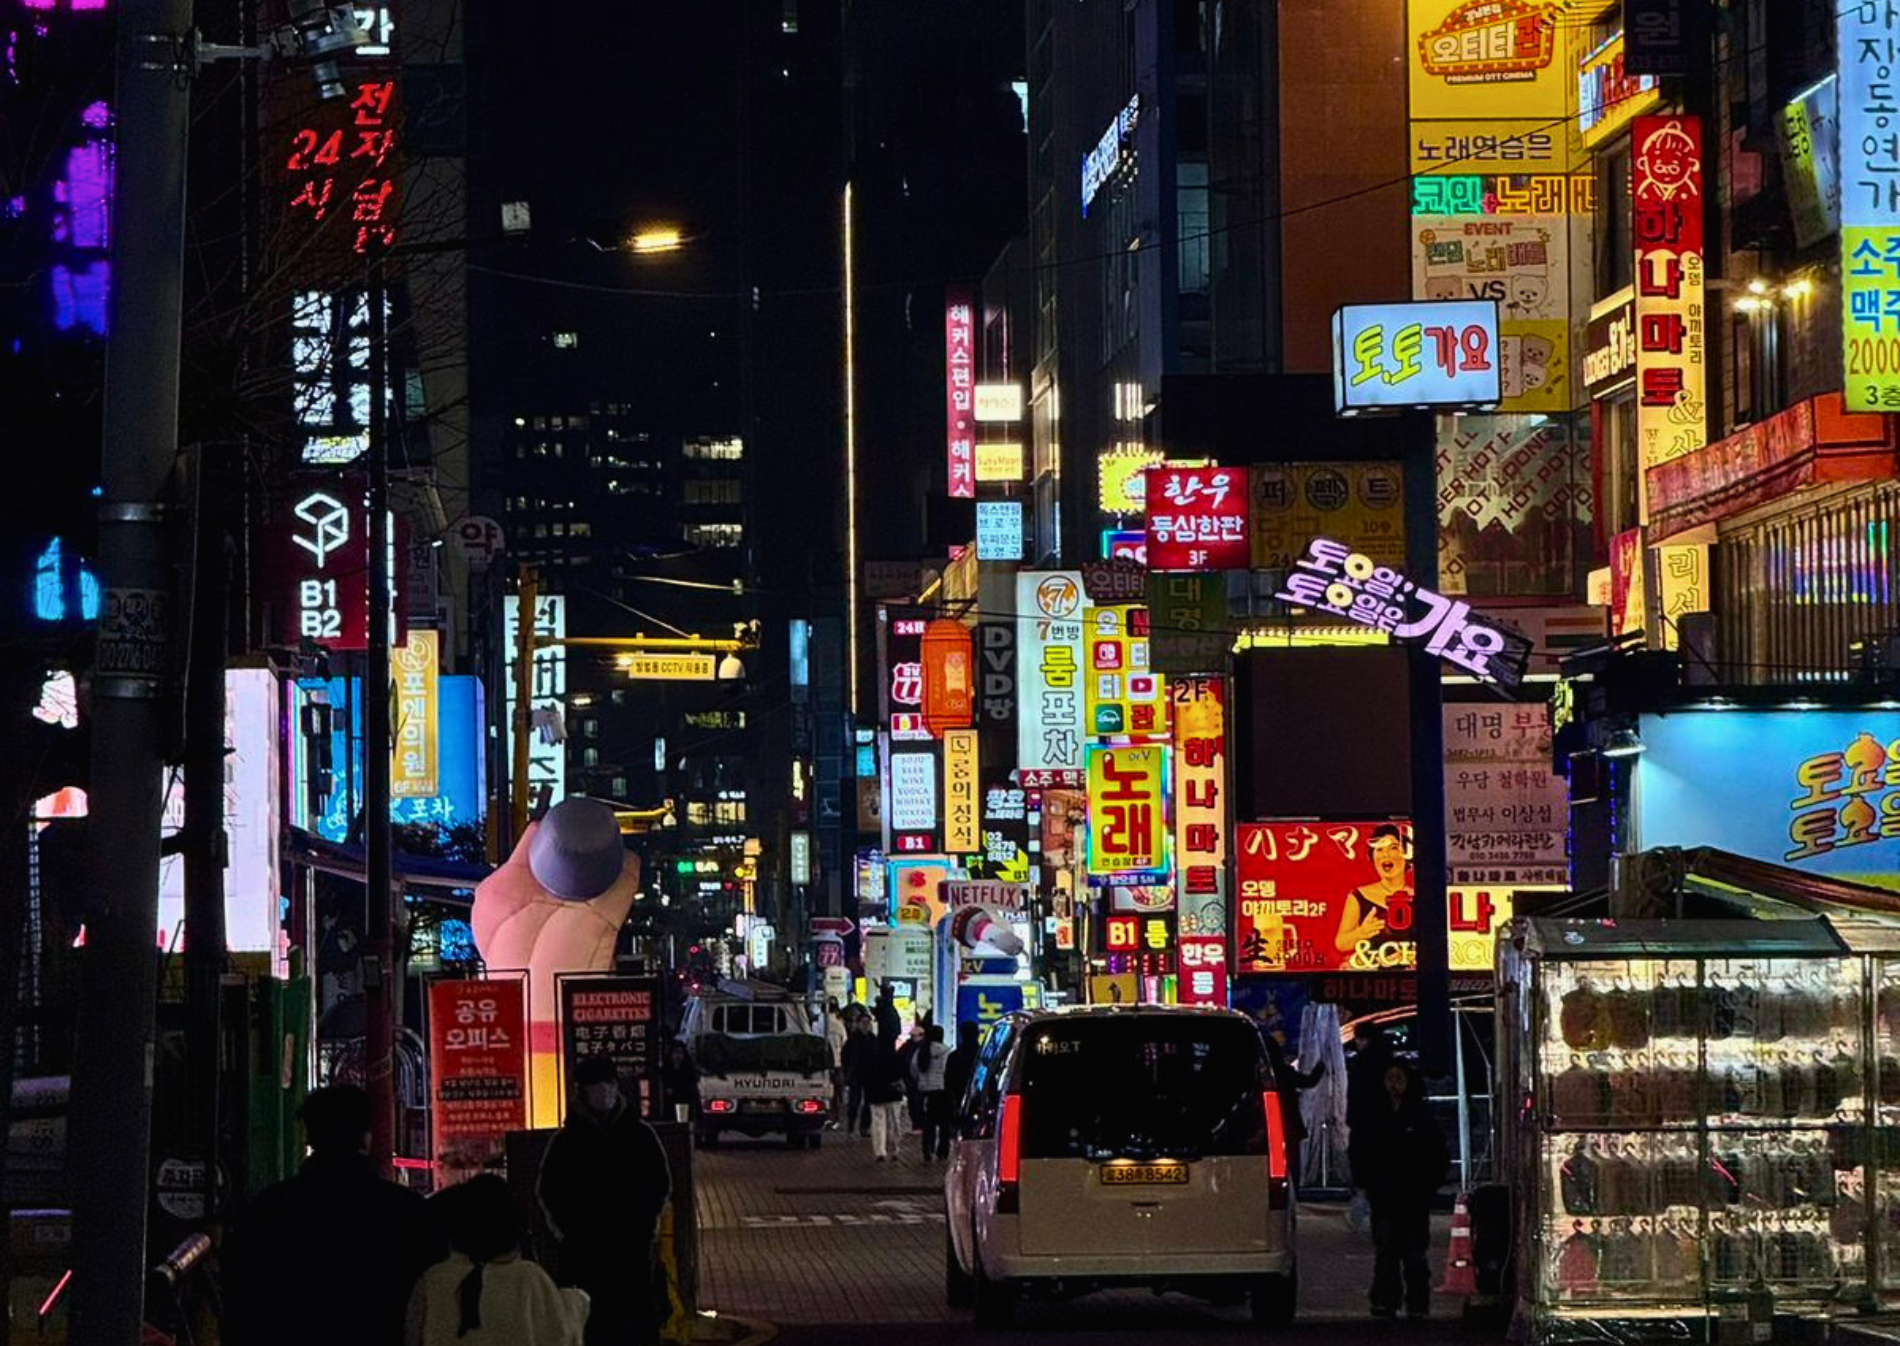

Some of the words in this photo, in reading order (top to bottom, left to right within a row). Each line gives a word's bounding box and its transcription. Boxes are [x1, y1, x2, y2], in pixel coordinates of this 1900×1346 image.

[1485, 72, 1501, 82] OTT
[1417, 134, 1552, 161] 노래연습은
[1464, 223, 1513, 236] EVENT
[1469, 281, 1506, 300] VS
[1163, 474, 1231, 509] 한우
[1151, 514, 1244, 543] 등심한판
[1188, 550, 1208, 566] 3F
[301, 579, 336, 608] B1
[301, 610, 341, 638] B2
[1037, 621, 1080, 640] 7번방
[661, 662, 684, 673] CCTV
[1176, 680, 1208, 702] 2F
[1456, 711, 1502, 740] 대명
[1101, 752, 1152, 855] 노래
[1453, 807, 1495, 824] 법무사
[905, 836, 925, 849] B1
[950, 885, 1017, 909] NETFLIX
[1241, 879, 1276, 897] 오뎅
[1109, 923, 1137, 945] B1
[1181, 943, 1225, 966] 한우
[572, 991, 652, 1007] ELECTRONIC
[455, 999, 498, 1024] 공유
[572, 1006, 652, 1022] CIGARETTES
[445, 1027, 511, 1051] 오피스
[734, 1078, 795, 1088] HYUNDAI
[1145, 1167, 1182, 1181] 8542
